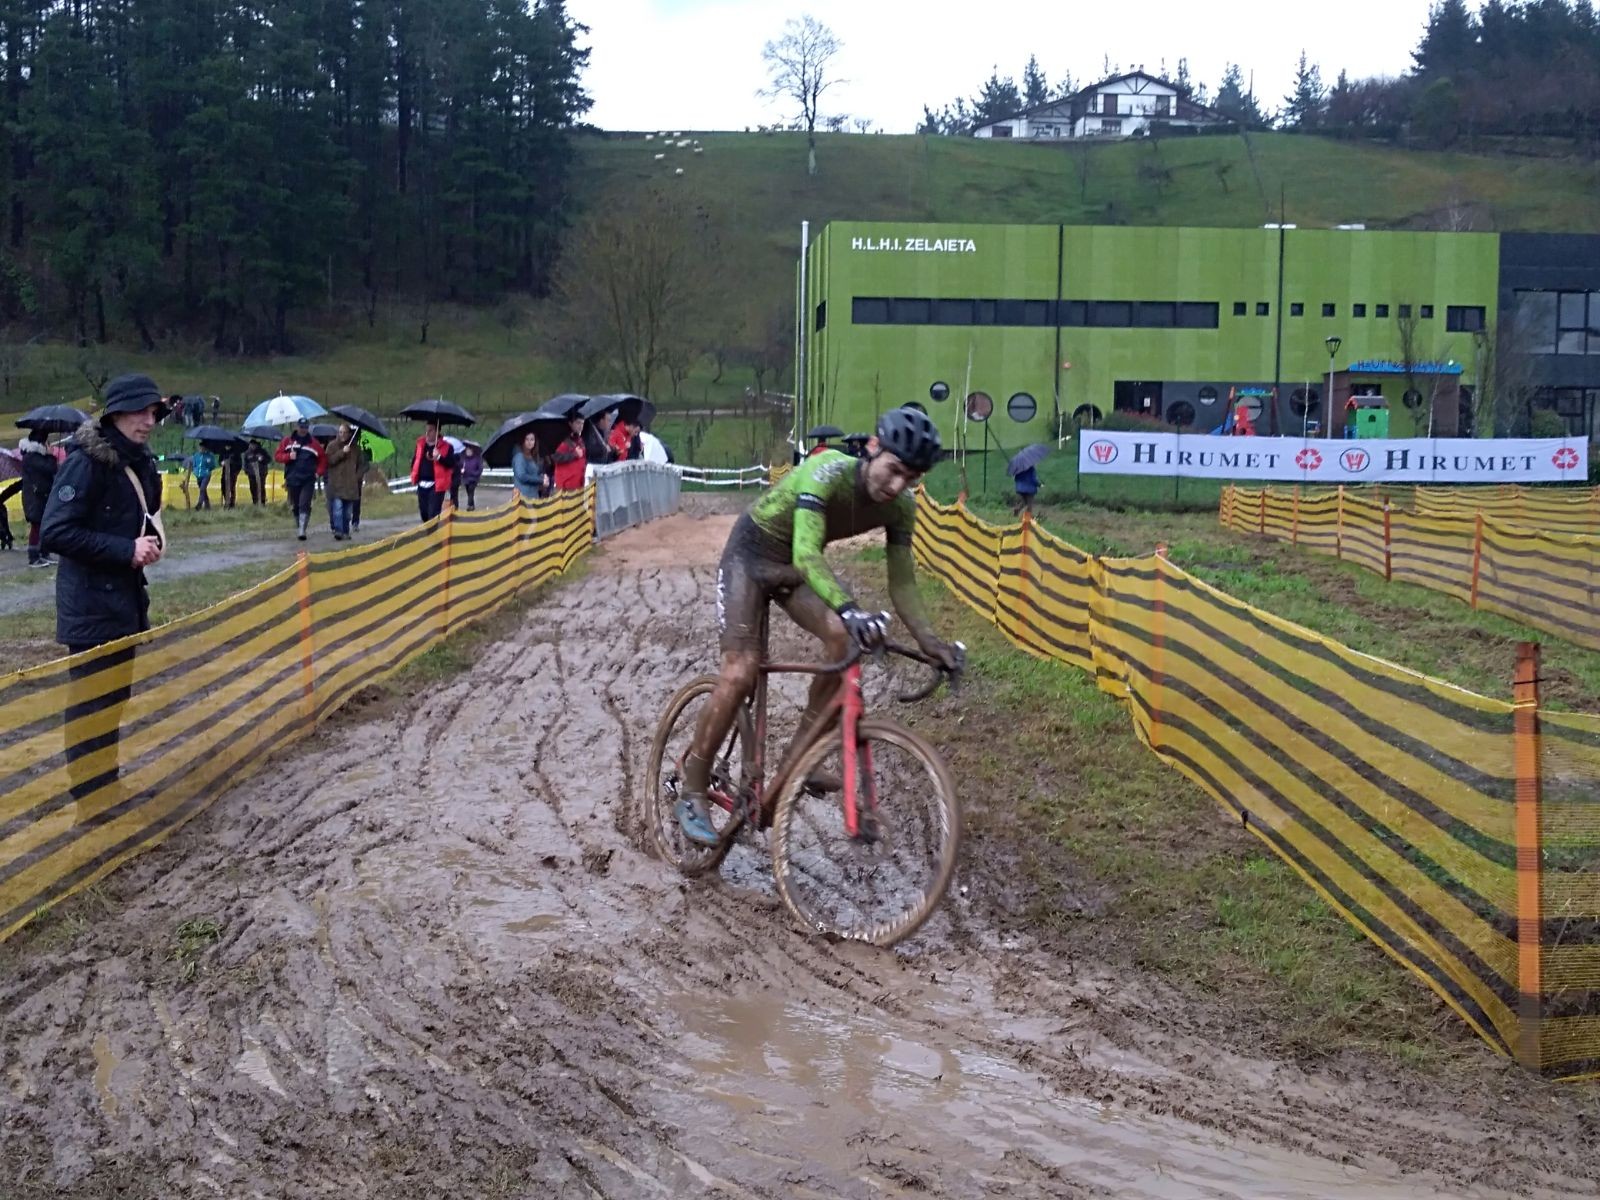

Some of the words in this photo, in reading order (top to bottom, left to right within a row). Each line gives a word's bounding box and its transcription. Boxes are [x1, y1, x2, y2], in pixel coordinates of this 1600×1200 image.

[852, 237, 902, 250] H.L.H.I.
[905, 238, 977, 252] ZELAIETA
[1133, 442, 1280, 469] HIRUMET
[1385, 449, 1537, 471] HIRUMET
